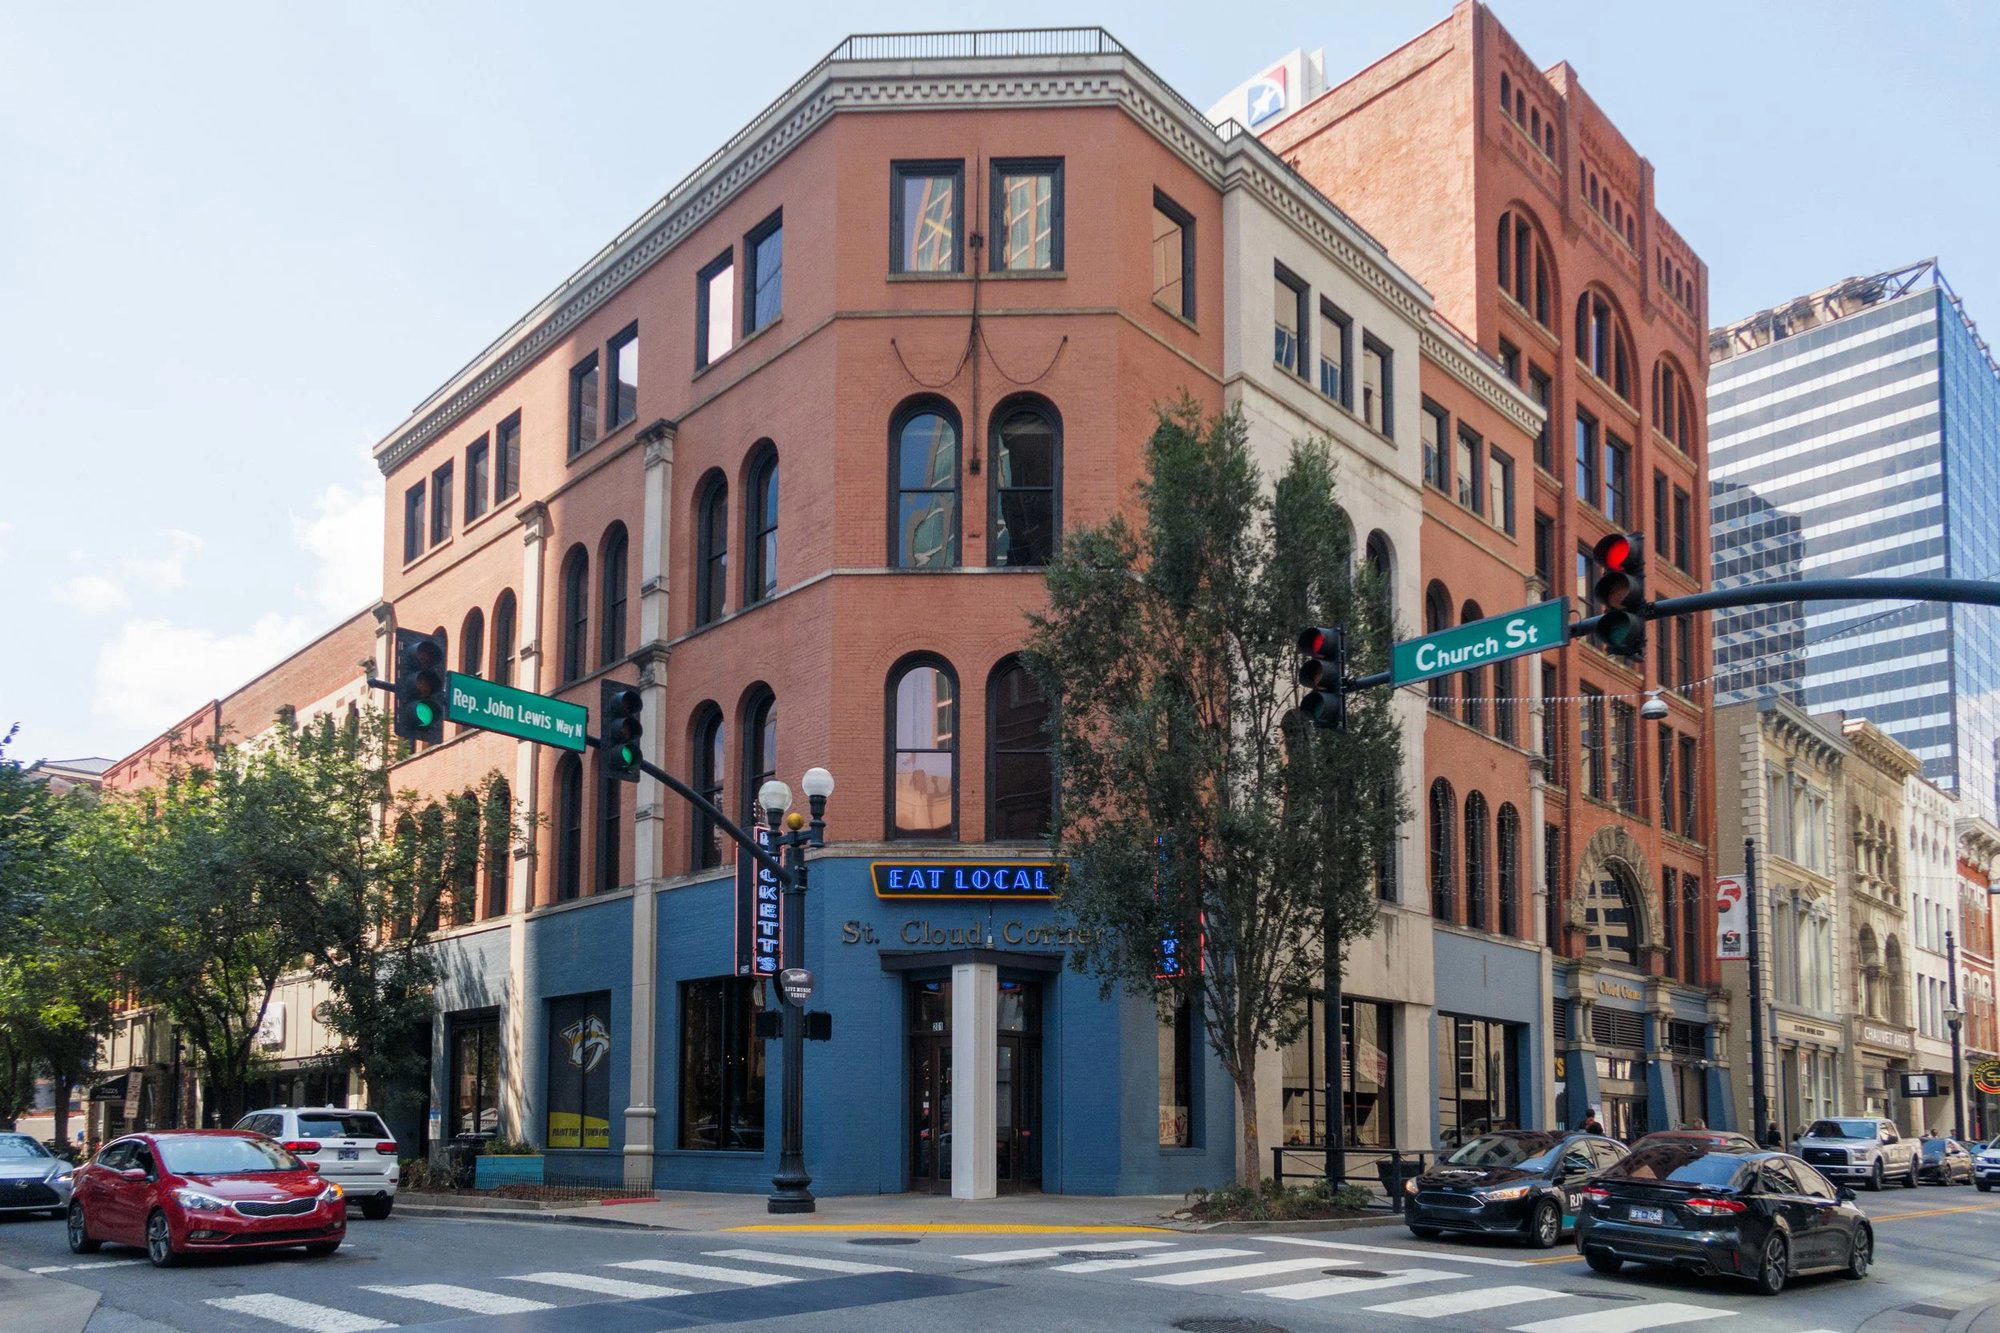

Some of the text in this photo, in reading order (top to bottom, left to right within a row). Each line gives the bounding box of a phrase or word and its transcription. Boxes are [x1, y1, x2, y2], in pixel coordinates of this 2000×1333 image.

[1416, 618, 1538, 671] Church St
[453, 688, 583, 739] Rep. John Lewis Way N
[889, 869, 1050, 891] EAT LOCAL
[842, 920, 880, 944] St.
[901, 920, 981, 945] Cloud
